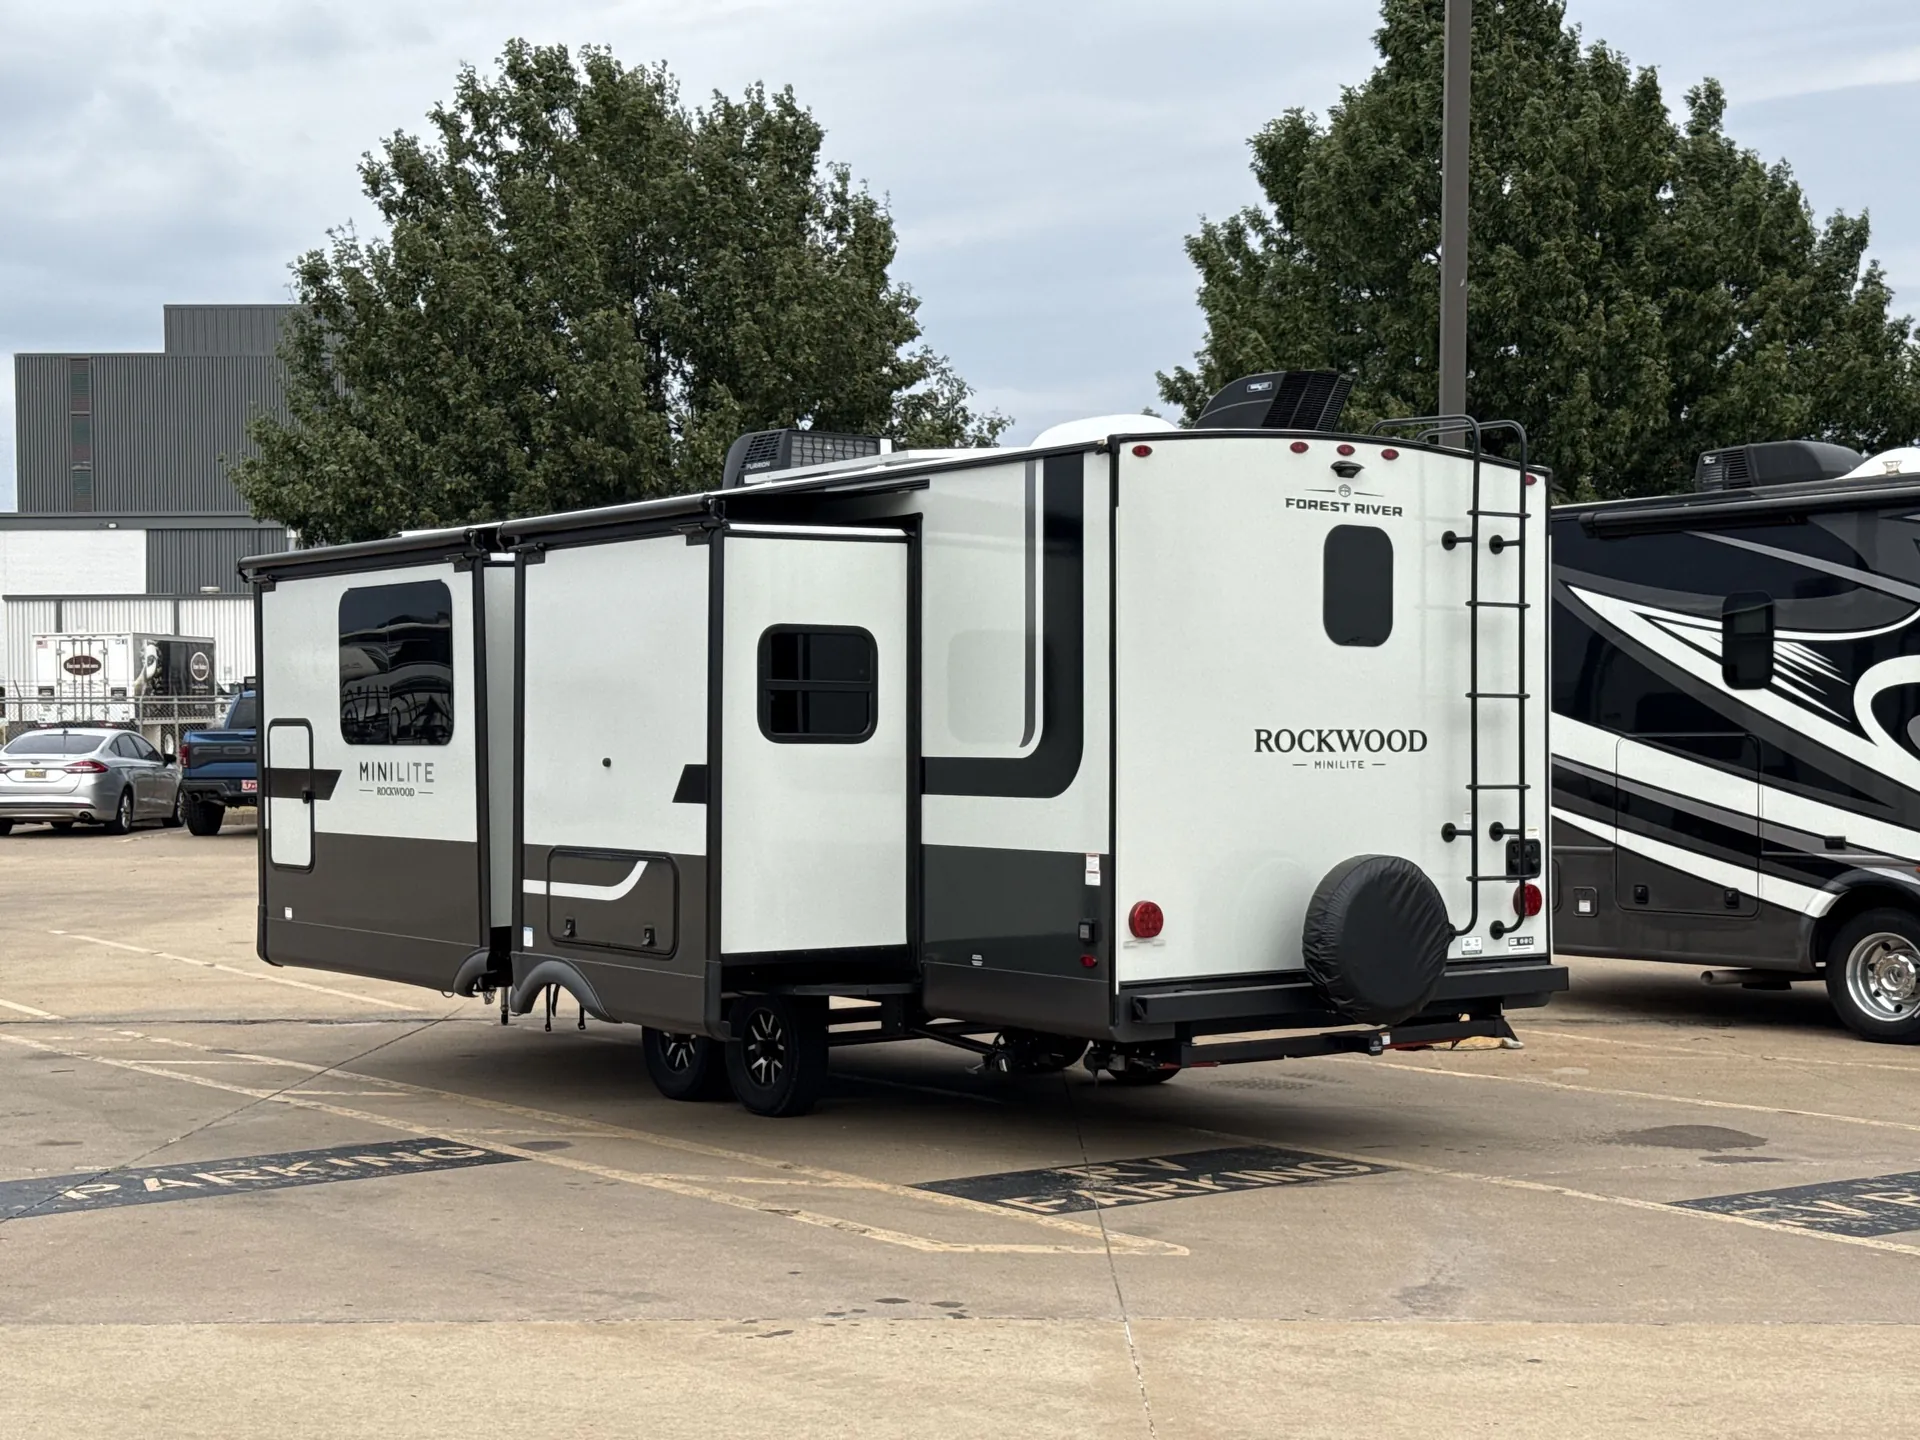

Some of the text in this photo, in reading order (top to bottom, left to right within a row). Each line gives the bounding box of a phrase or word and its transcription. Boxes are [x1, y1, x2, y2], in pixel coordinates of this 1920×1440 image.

[1285, 498, 1403, 517] FOREST RIVER
[193, 745, 257, 755] FO
[1254, 728, 1428, 753] ROCKWOOD
[359, 761, 435, 783] MINILITE
[1314, 760, 1366, 770] MINILITE
[376, 787, 416, 797] ROCKWOOD
[1055, 1157, 1191, 1181] RV
[995, 1161, 1372, 1213] PARKING
